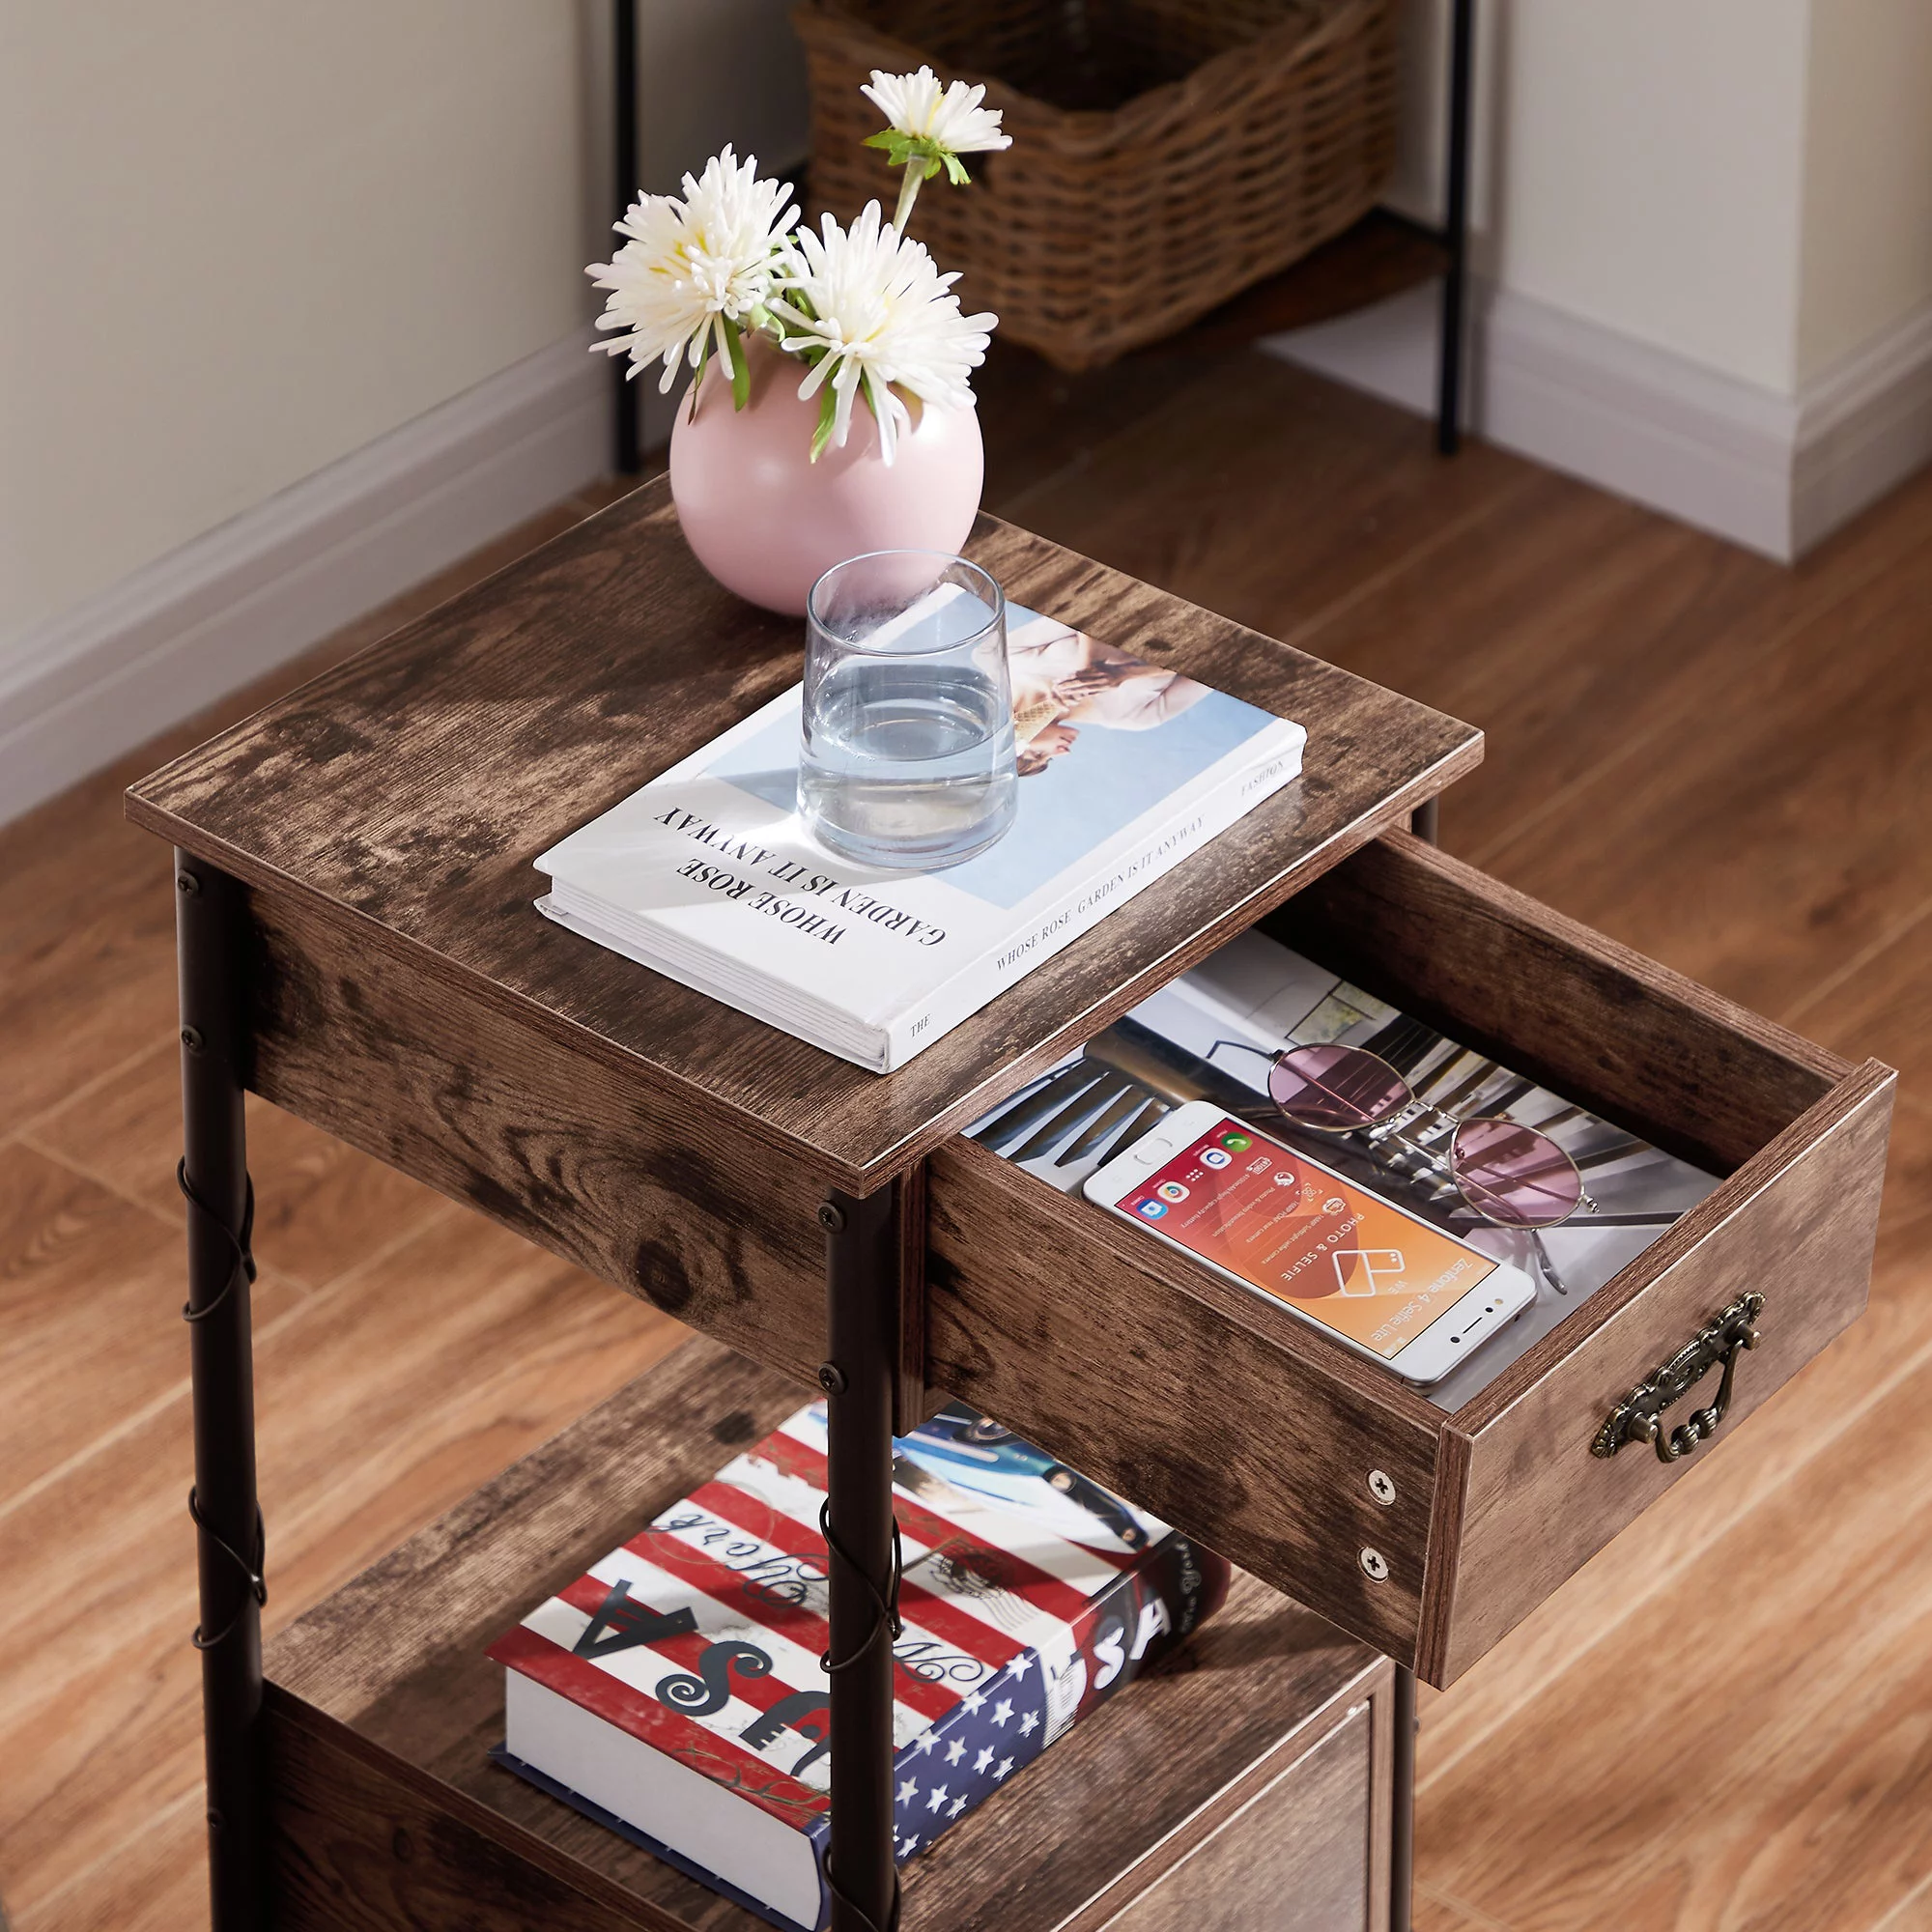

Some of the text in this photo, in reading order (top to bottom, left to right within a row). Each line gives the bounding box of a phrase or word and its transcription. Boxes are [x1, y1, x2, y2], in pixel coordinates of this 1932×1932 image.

[1240, 759, 1285, 797] FASHION
[653, 807, 946, 947] GARDEN IS IT ANYWAY
[996, 813, 1207, 971] WHOSE ROSE GARDEN IS IT ANYWAY
[676, 857, 848, 945] WHOSE ROSE
[910, 1013, 930, 1038] THE
[1280, 1212, 1365, 1281] PHOTO & SELFIE
[1387, 1280, 1408, 1295] WE
[1417, 1293, 1432, 1303] 4
[1370, 1321, 1398, 1342] Lite
[1389, 1301, 1423, 1326] Selfie
[1049, 1598, 1172, 1721] USA
